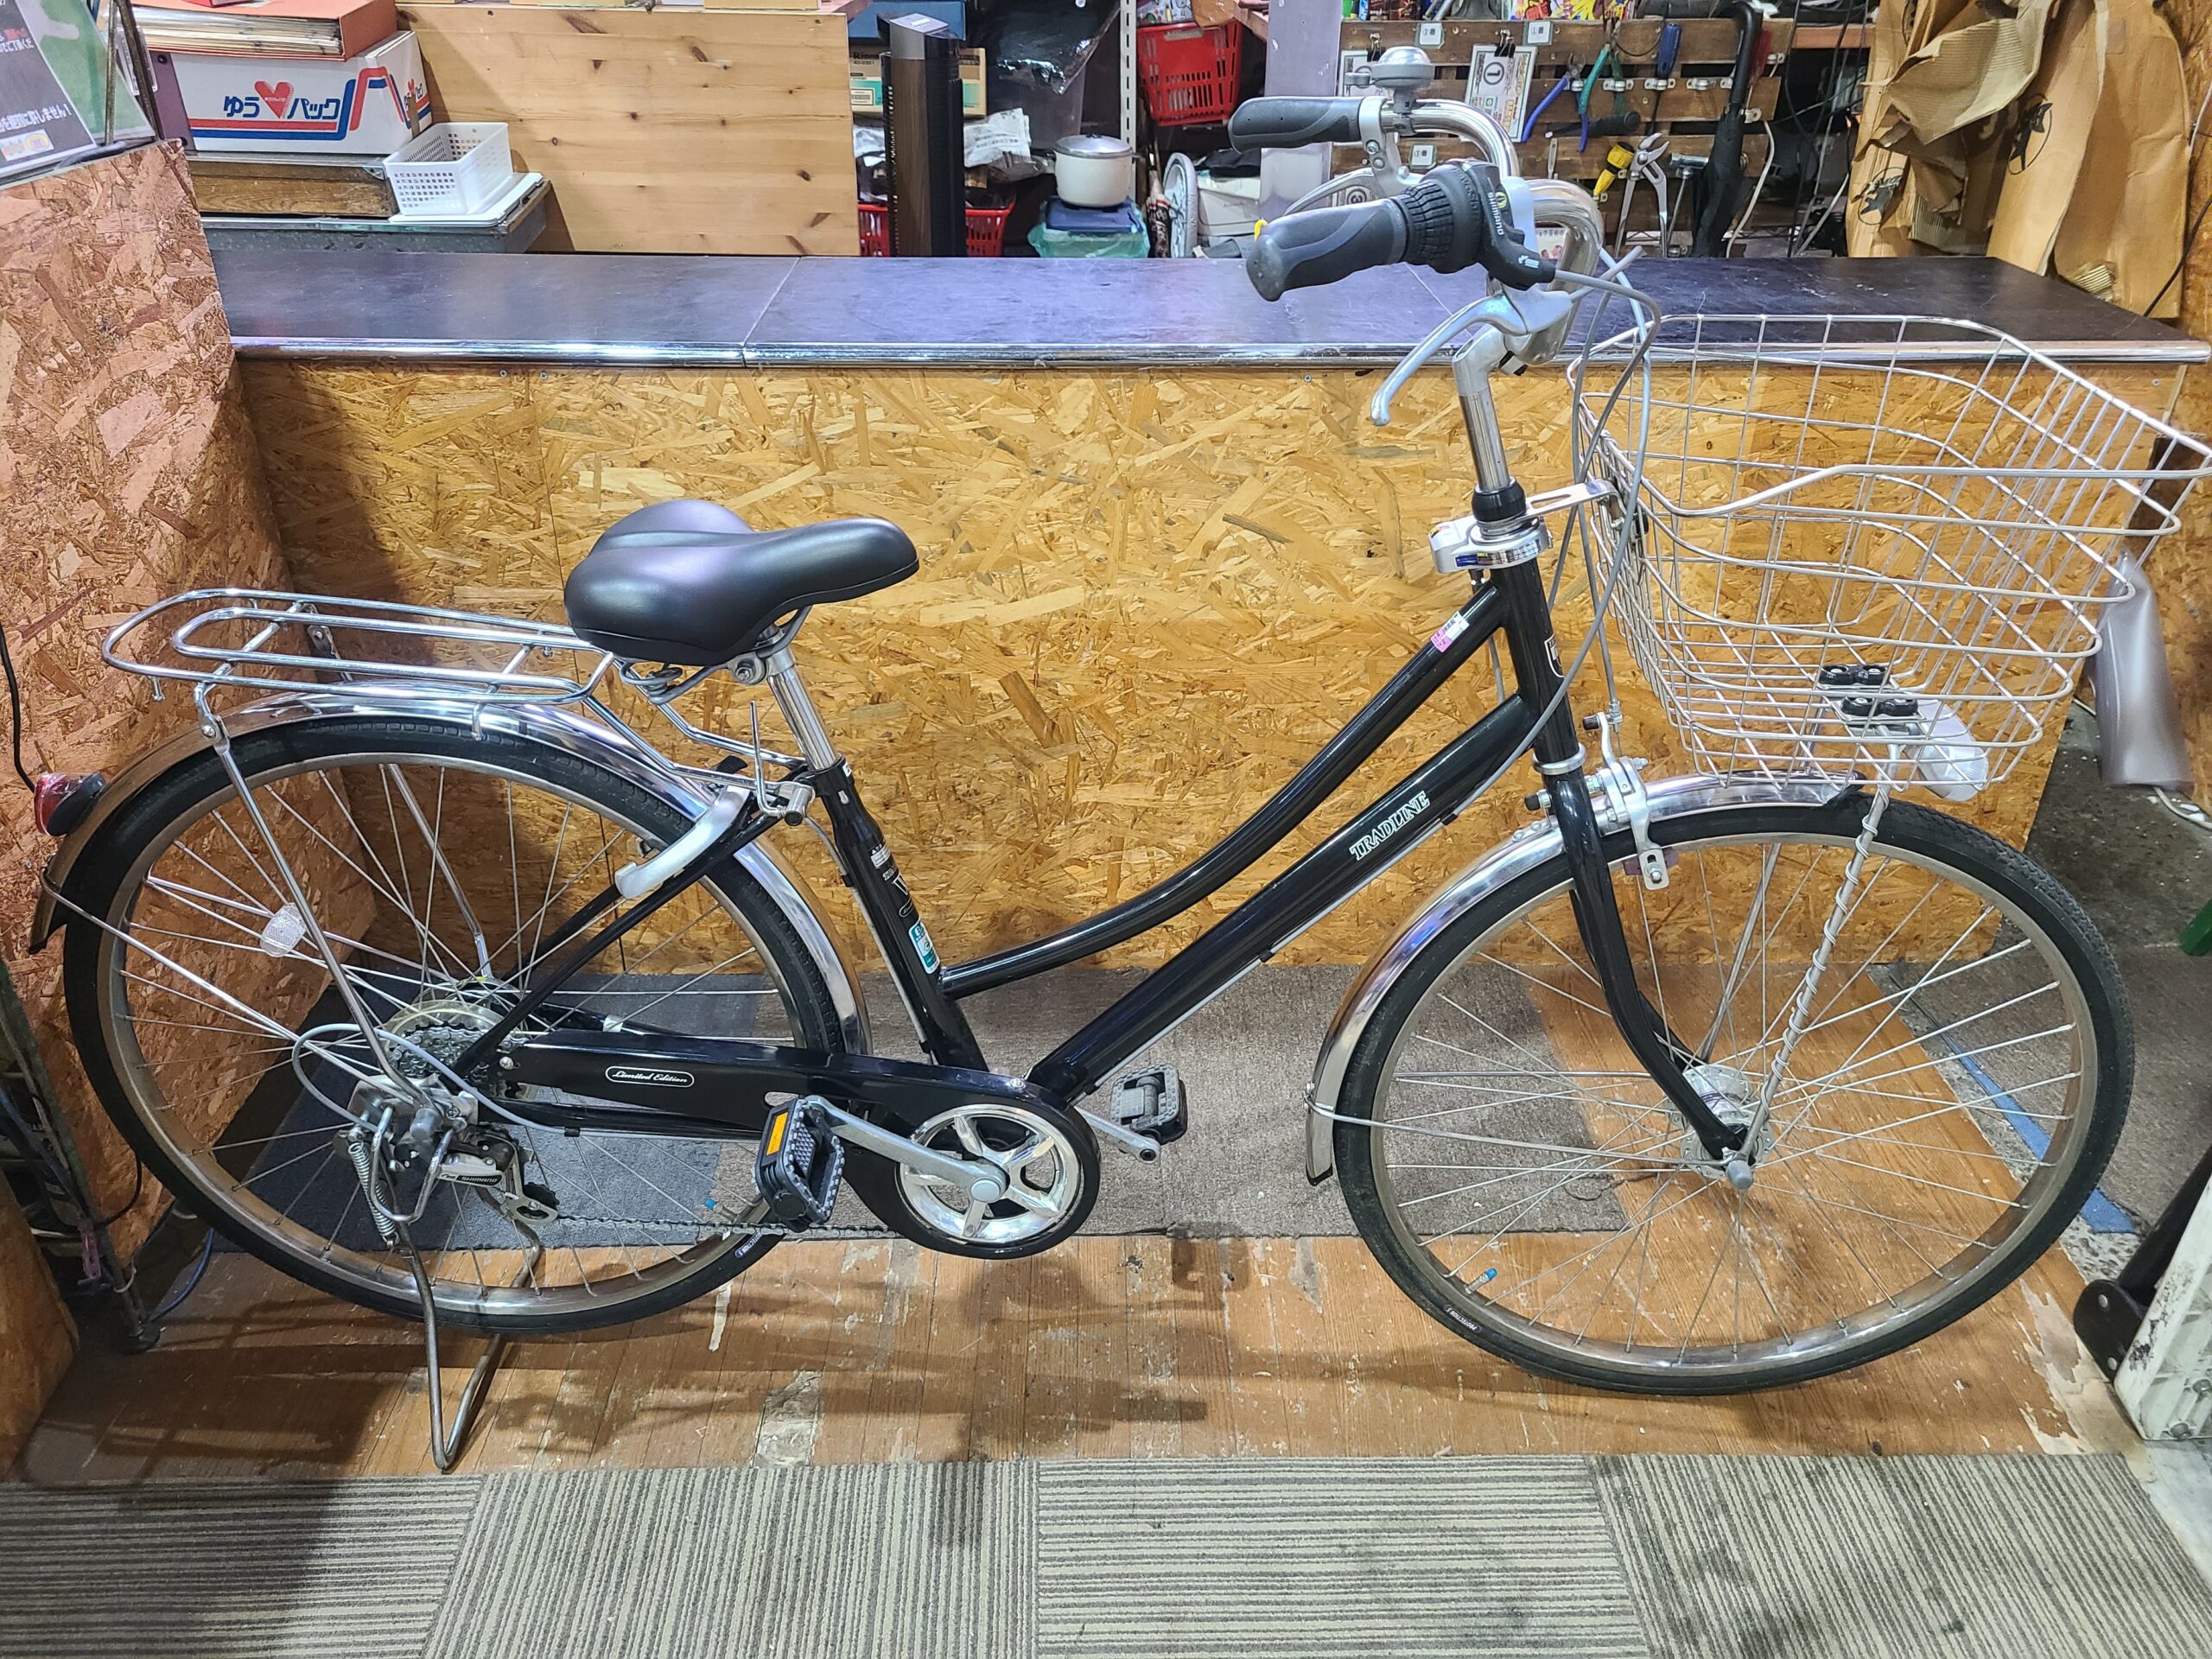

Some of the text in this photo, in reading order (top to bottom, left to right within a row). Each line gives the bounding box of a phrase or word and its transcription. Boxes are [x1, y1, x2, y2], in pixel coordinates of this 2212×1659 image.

[1487, 192, 1504, 236] SHIMANO
[1349, 790, 1431, 861] TRADLINE
[612, 1071, 688, 1084] Limited Edition
[1449, 1310, 1478, 1331] PROTECTION
